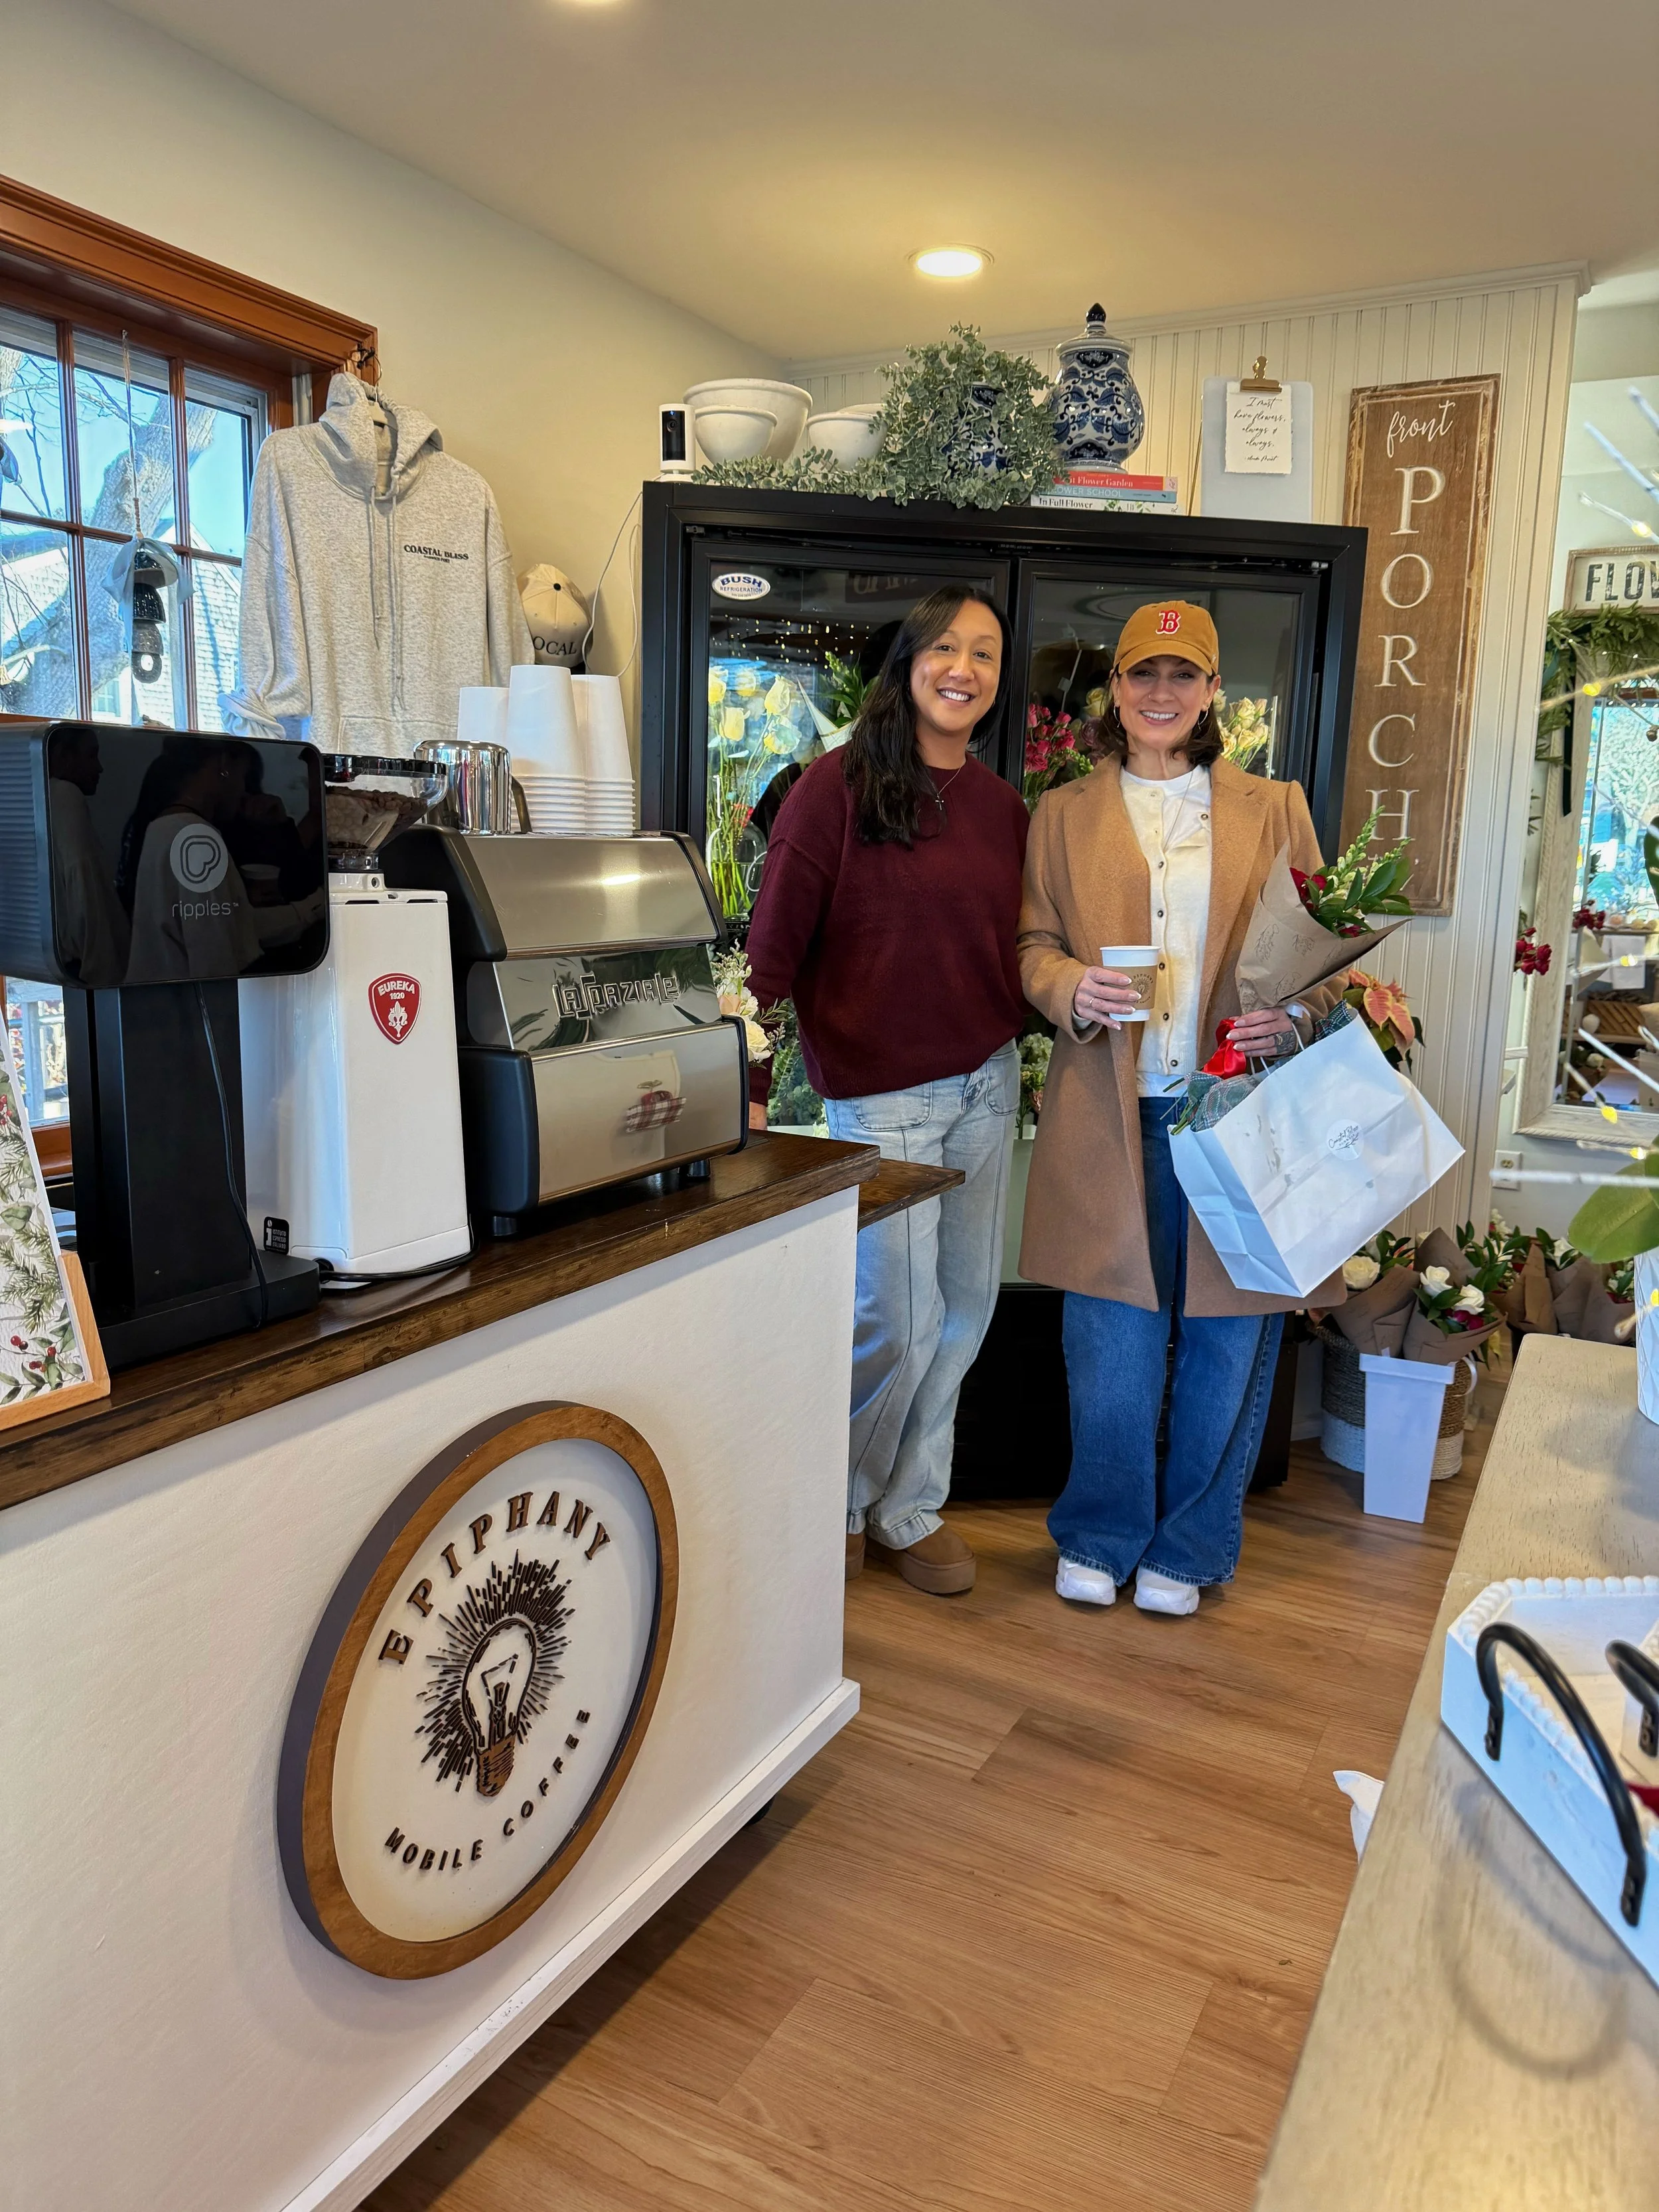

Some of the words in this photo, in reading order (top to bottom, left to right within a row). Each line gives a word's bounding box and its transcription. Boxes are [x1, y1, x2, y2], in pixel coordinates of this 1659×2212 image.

[1234, 409, 1252, 419] have
[1242, 423, 1269, 437] always
[1387, 400, 1456, 458] front
[1078, 476, 1104, 485] Flower
[1106, 479, 1133, 487] Garden
[1054, 486, 1084, 496] OWER
[1087, 488, 1123, 498] SCHOOL
[1039, 497, 1047, 506] In
[1066, 499, 1093, 508] Flower
[403, 545, 442, 556] COASTAL
[444, 551, 469, 560] BLISS
[720, 576, 762, 587] BUSH
[1155, 609, 1181, 634] B
[533, 636, 577, 656] OCAL
[1365, 466, 1446, 841] PORCH
[378, 980, 415, 996] EUREKA
[379, 1491, 611, 1664] EPIPHANY
[385, 1826, 483, 1871] MOBILE
[503, 1710, 591, 1836] COFFEE
